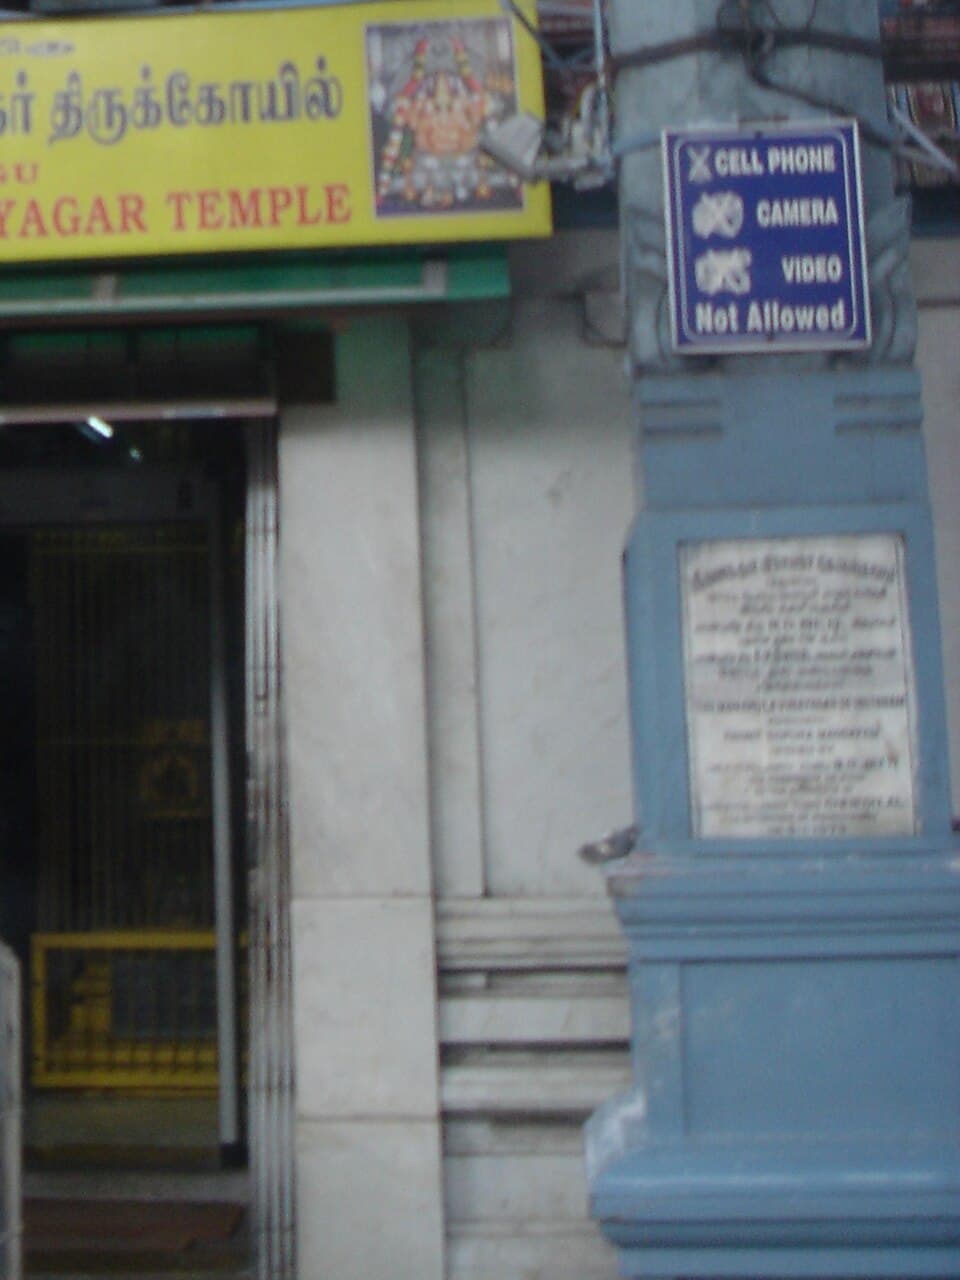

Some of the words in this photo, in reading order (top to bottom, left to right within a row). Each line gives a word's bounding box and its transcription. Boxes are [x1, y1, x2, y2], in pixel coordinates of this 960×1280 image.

[48, 55, 343, 146] திருக்கோயில்
[715, 147, 763, 176] CELL
[767, 145, 836, 174] PHONE
[167, 183, 352, 233] TEMPLE
[757, 197, 838, 228] CAMERA
[781, 254, 842, 284] VIDEO
[695, 301, 738, 334] Not
[747, 298, 845, 334] Allowed
